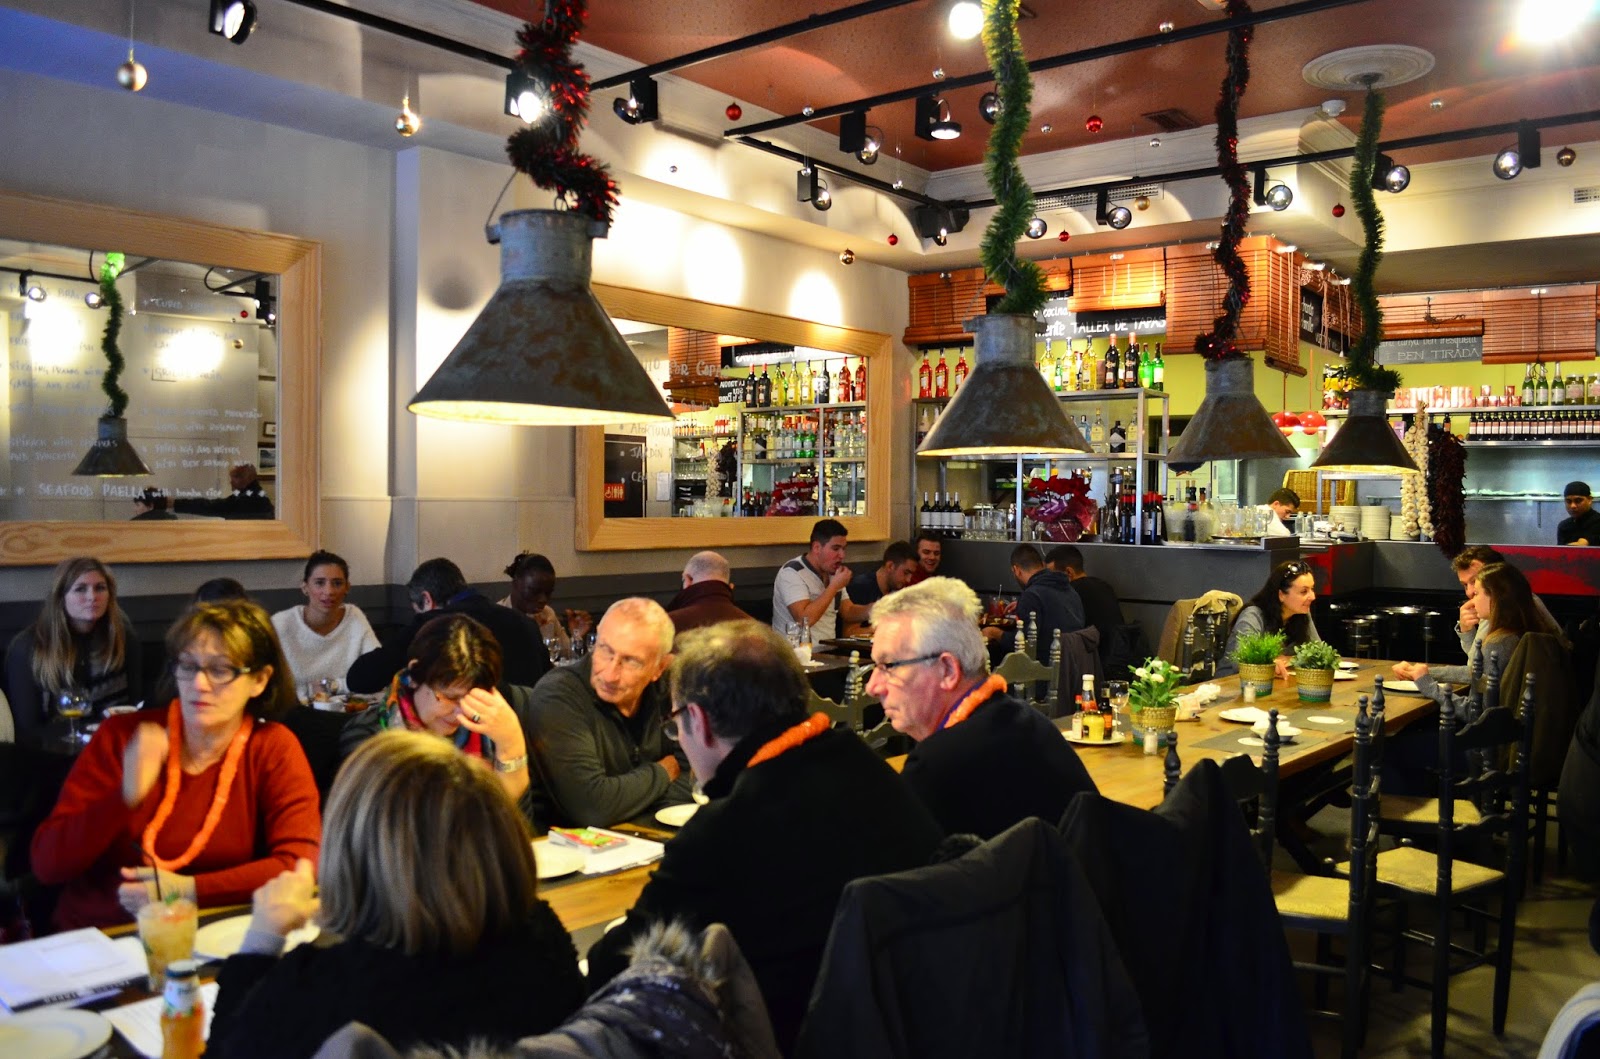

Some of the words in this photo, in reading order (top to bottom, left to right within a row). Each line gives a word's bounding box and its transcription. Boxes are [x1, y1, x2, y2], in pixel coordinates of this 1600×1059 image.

[1070, 319, 1109, 334] TALLER
[1114, 319, 1128, 333] DE
[1132, 316, 1166, 331] TAPAS
[1397, 351, 1425, 361] BEN
[1431, 347, 1480, 360] TIRADA
[39, 483, 94, 498] SEAFOOD
[102, 484, 146, 499] PAELLA
